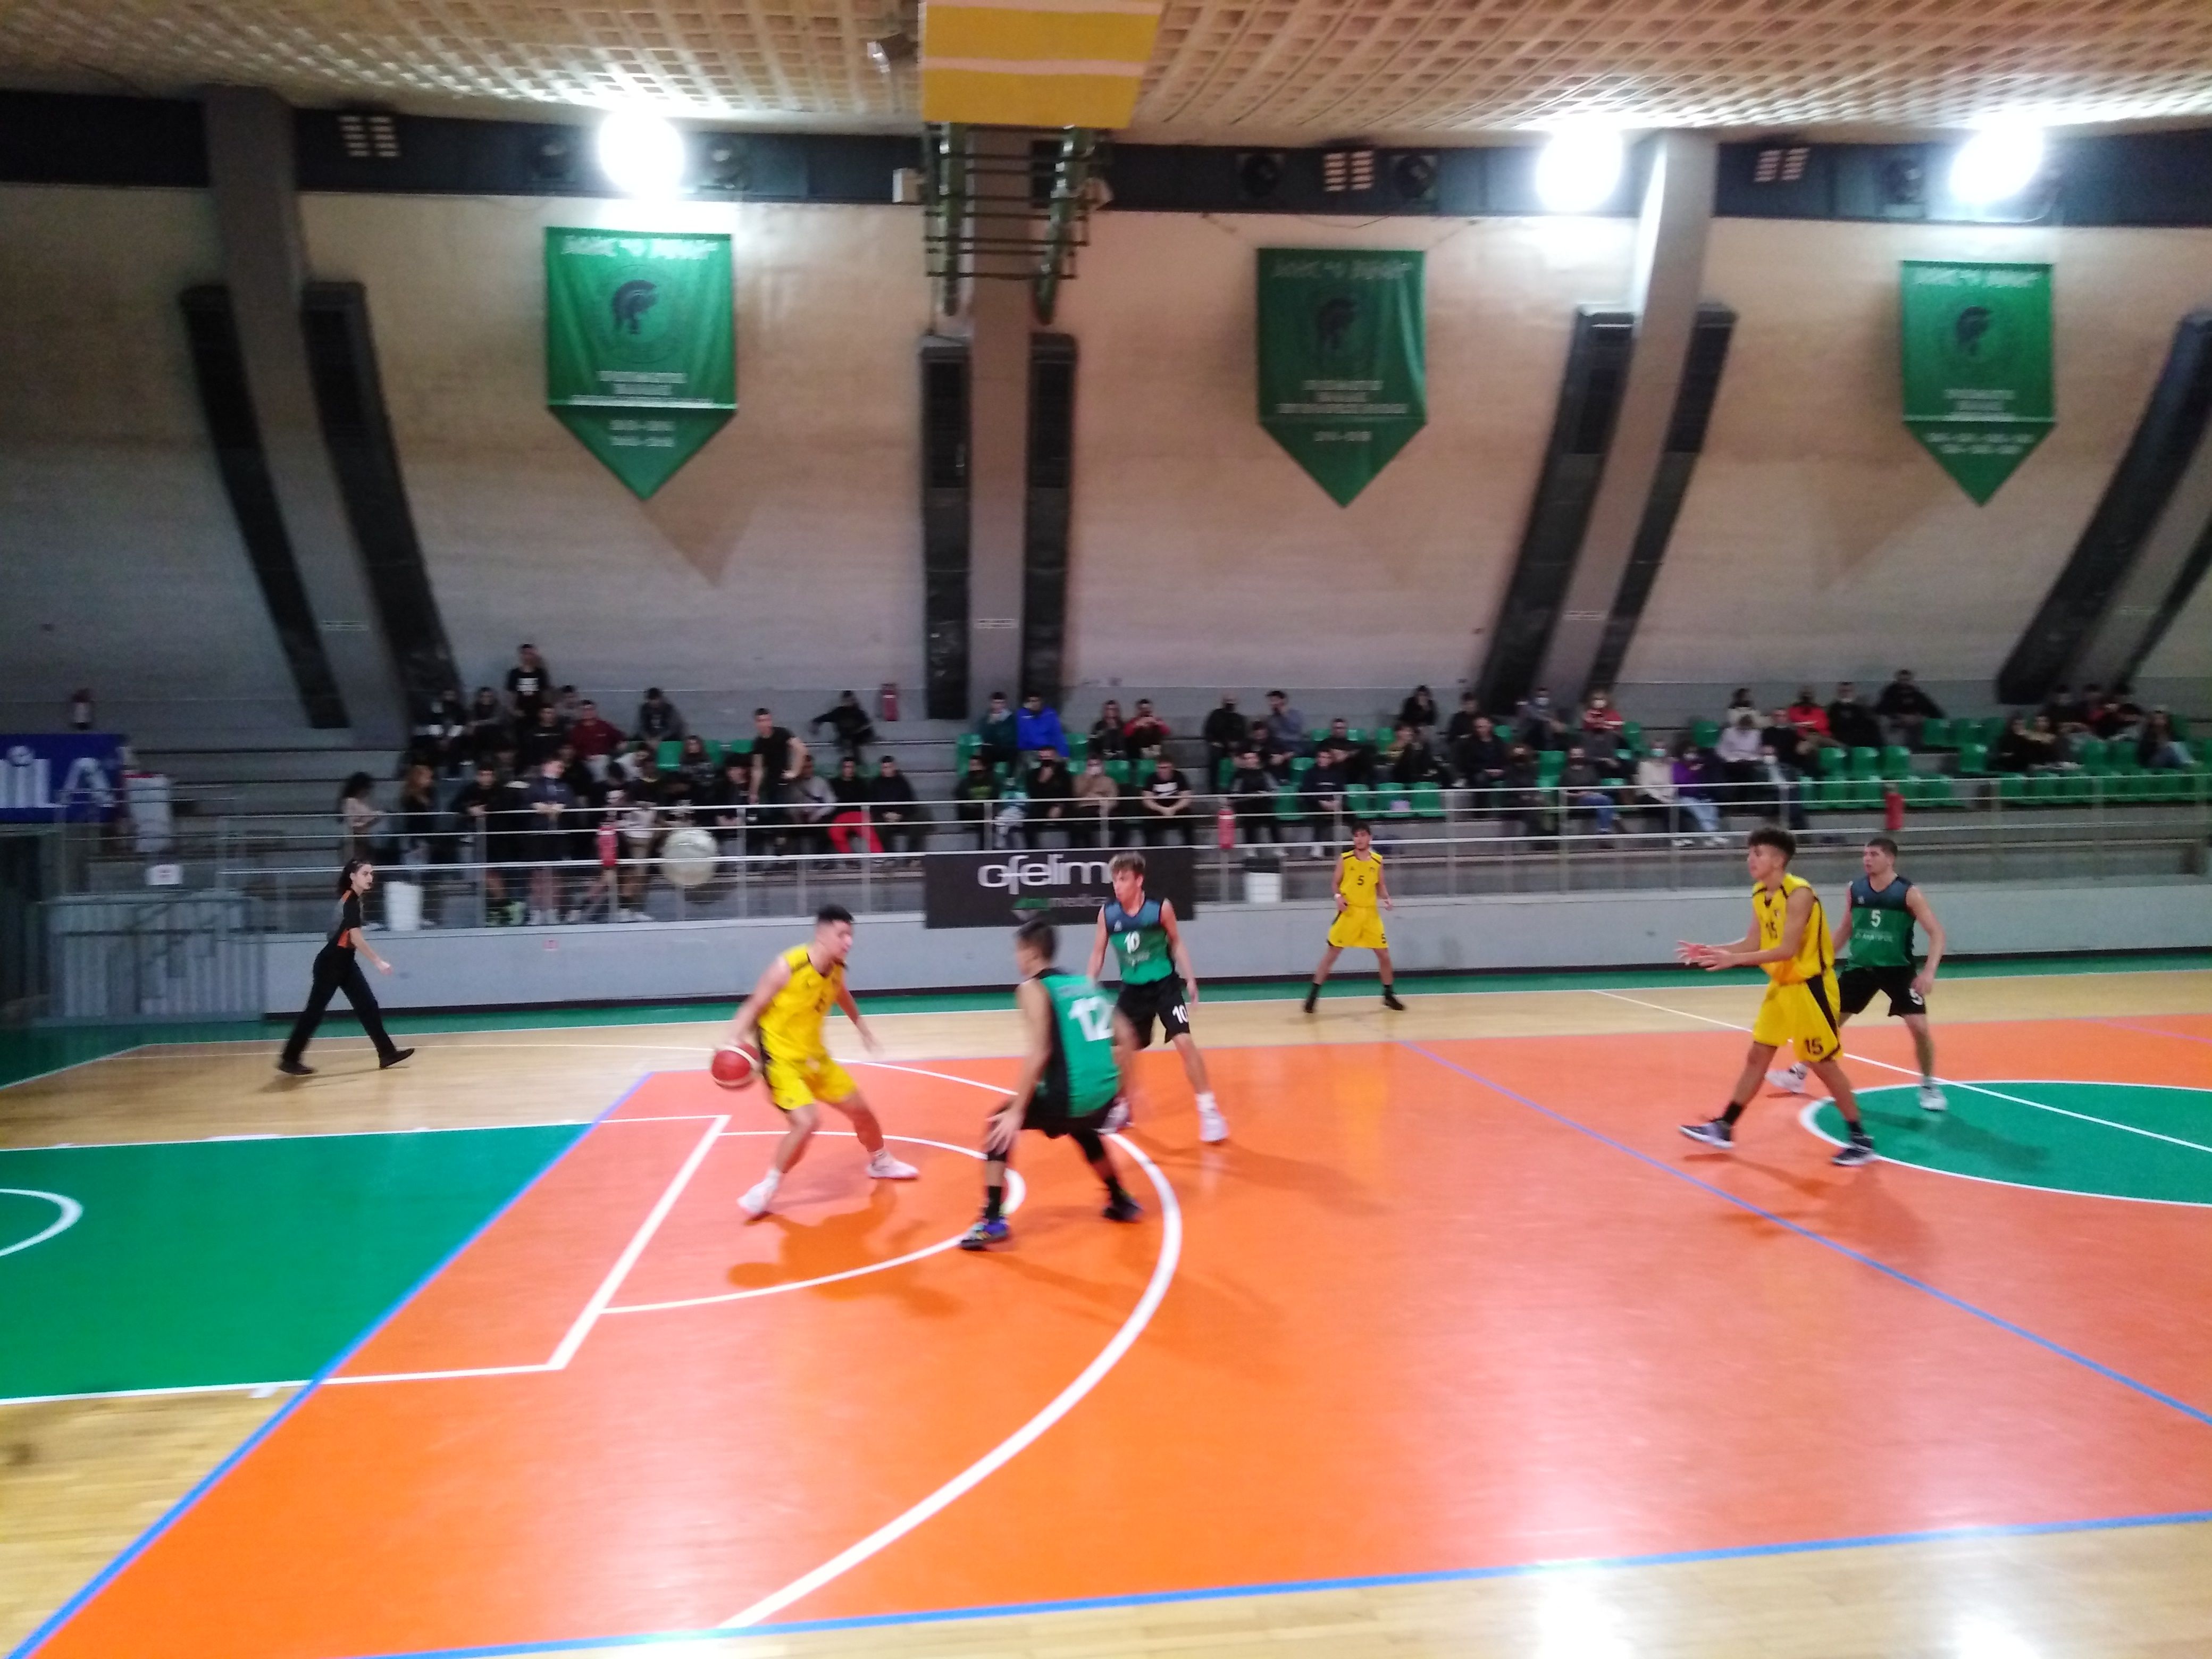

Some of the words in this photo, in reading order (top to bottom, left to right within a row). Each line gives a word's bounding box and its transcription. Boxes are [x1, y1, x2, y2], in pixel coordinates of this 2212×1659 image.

[1356, 875, 1364, 886] 5
[1871, 909, 1881, 927] 5
[1124, 931, 1141, 954] 10
[1068, 996, 1115, 1042] 12
[1172, 1004, 1188, 1024] 10
[1805, 1036, 1824, 1055] 15
